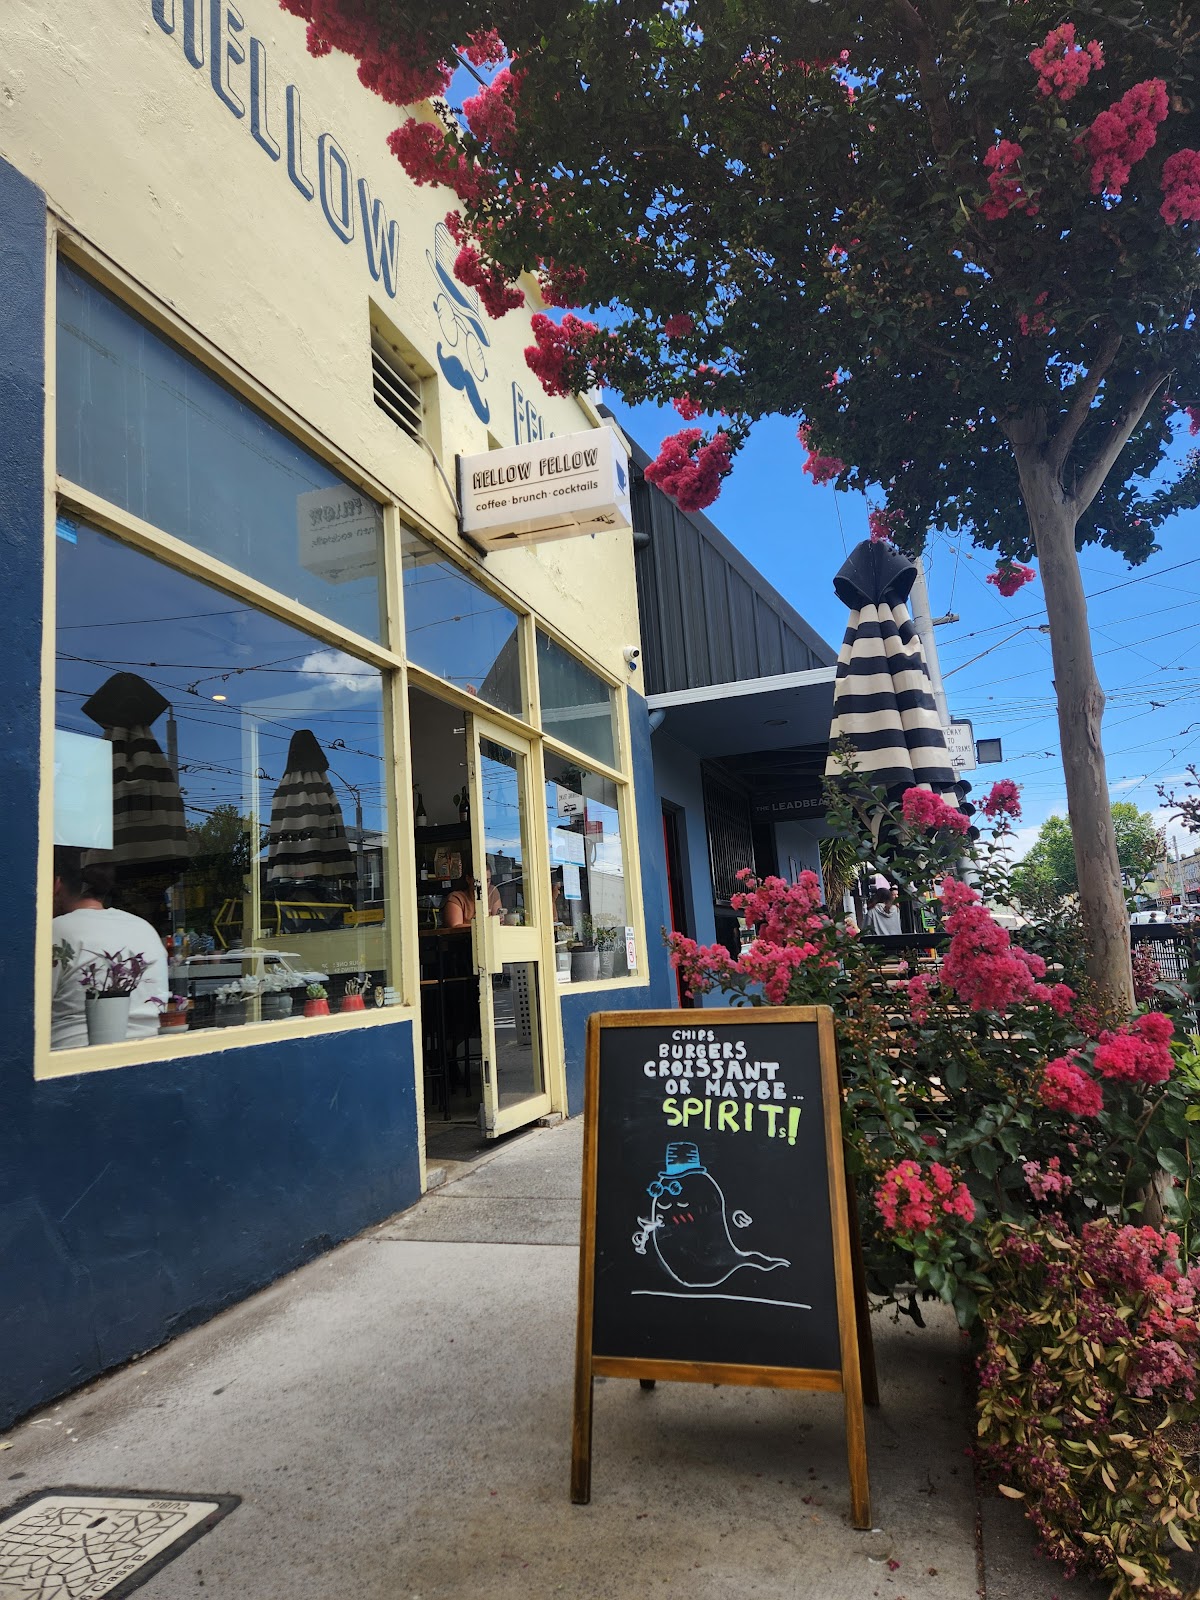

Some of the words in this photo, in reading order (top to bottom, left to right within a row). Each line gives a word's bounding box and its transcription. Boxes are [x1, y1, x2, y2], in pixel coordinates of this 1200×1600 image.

[473, 461, 532, 490] MELLOW
[539, 448, 598, 477] FELLOW
[476, 498, 507, 511] coffee
[512, 490, 547, 505] brunch
[553, 480, 598, 497] cocktails
[672, 1029, 715, 1042] CHIPS
[658, 1041, 747, 1060] BURGERS
[643, 1058, 780, 1080] CROISSANT
[665, 1078, 691, 1095] OR
[91, 1563, 136, 1592] Class
[131, 1554, 148, 1562] B
